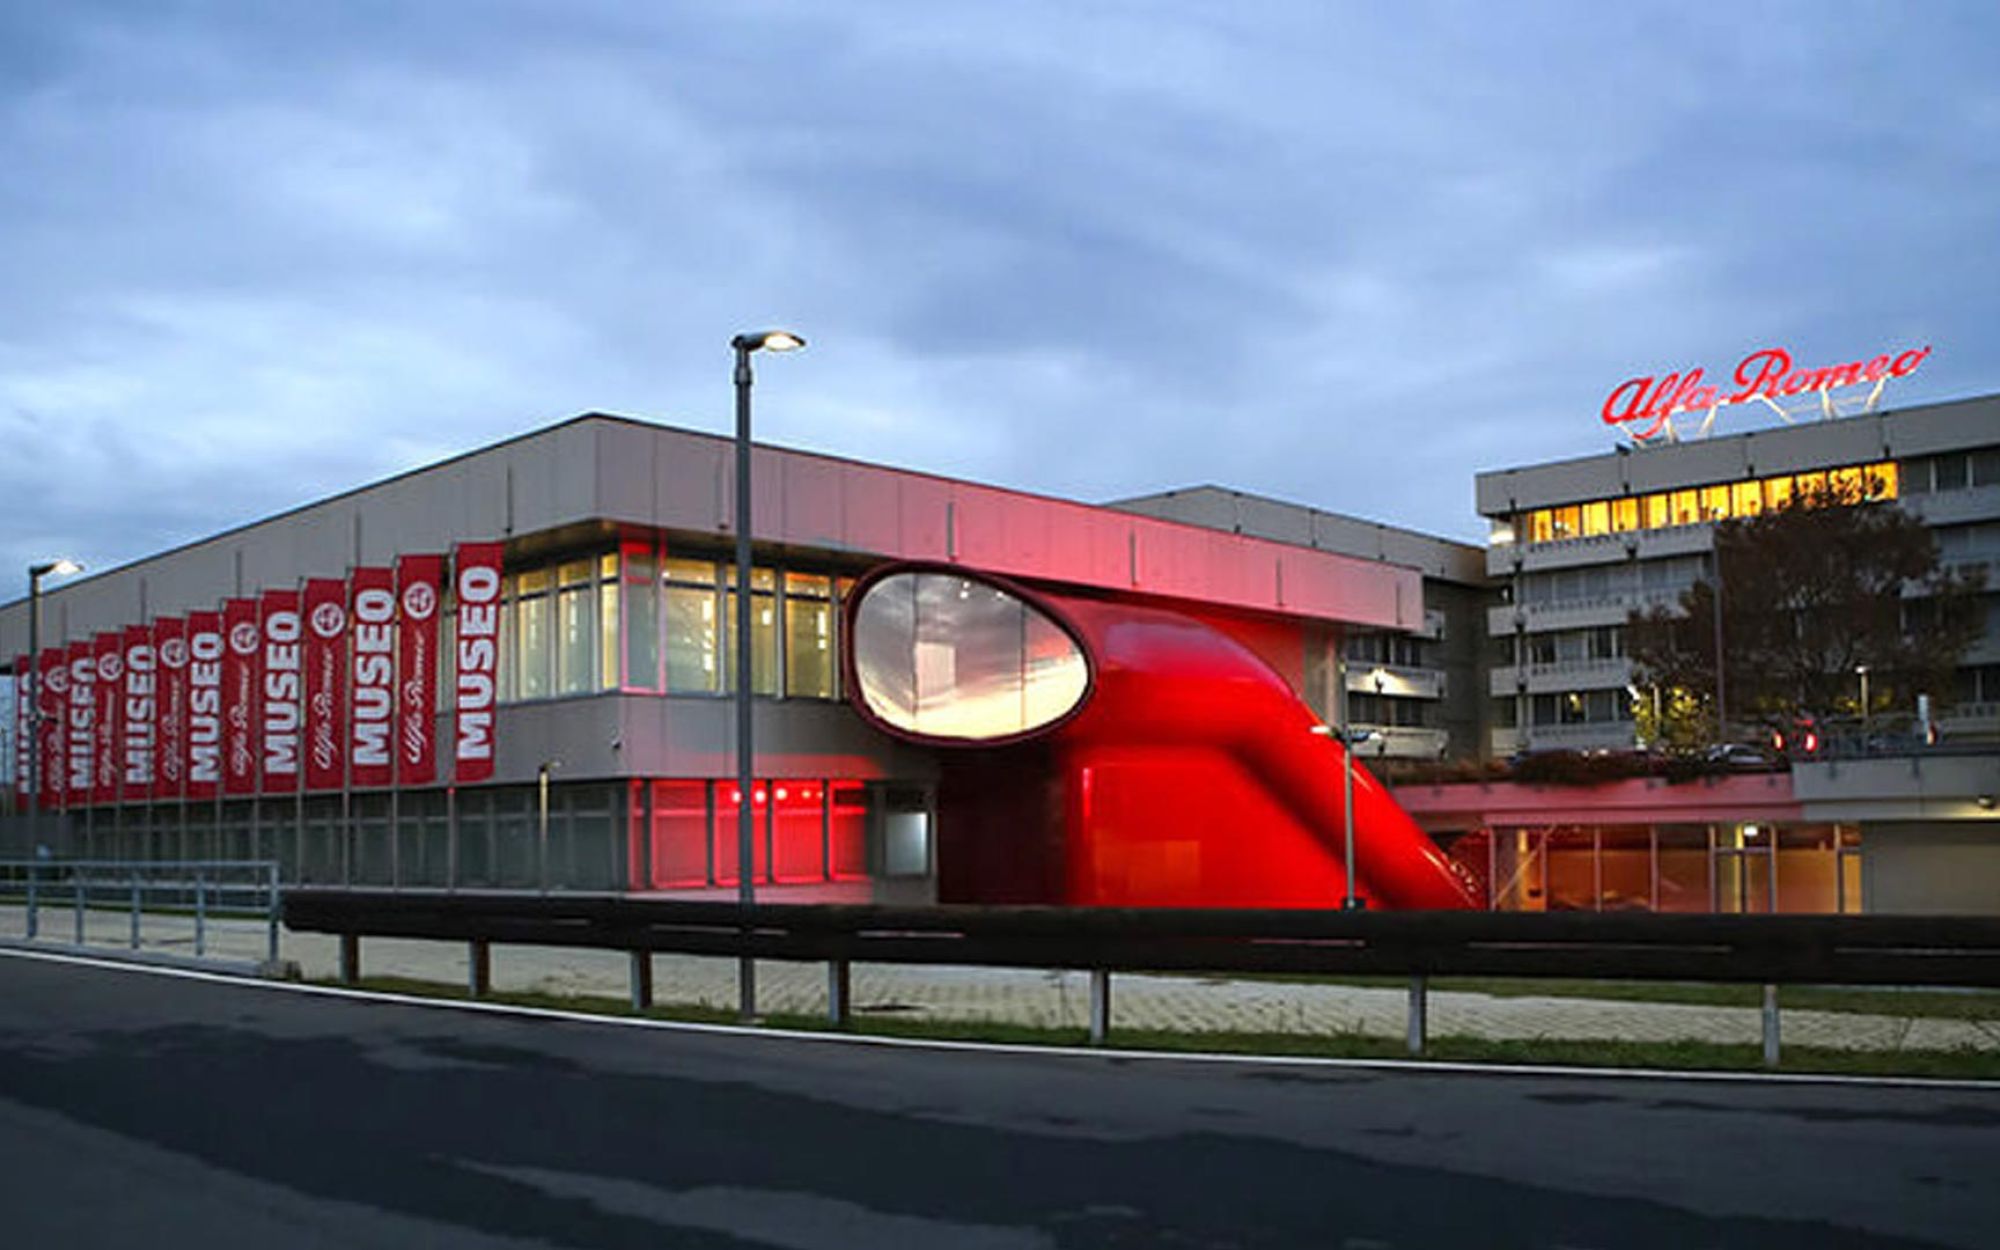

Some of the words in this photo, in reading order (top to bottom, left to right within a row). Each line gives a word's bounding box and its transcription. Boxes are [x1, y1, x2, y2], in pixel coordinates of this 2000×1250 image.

[1601, 367, 1719, 440] Alfa
[1727, 346, 1932, 404] Romeo
[265, 611, 300, 774] MUSEO
[312, 646, 333, 720] Romeo
[353, 588, 394, 765] MUSEO
[403, 630, 425, 710] Romeo
[457, 566, 499, 759] MUSEO
[190, 632, 223, 783] MUSEO
[314, 720, 338, 770] Alfa
[404, 711, 427, 764] Alfa
[231, 731, 254, 777] Alfa
